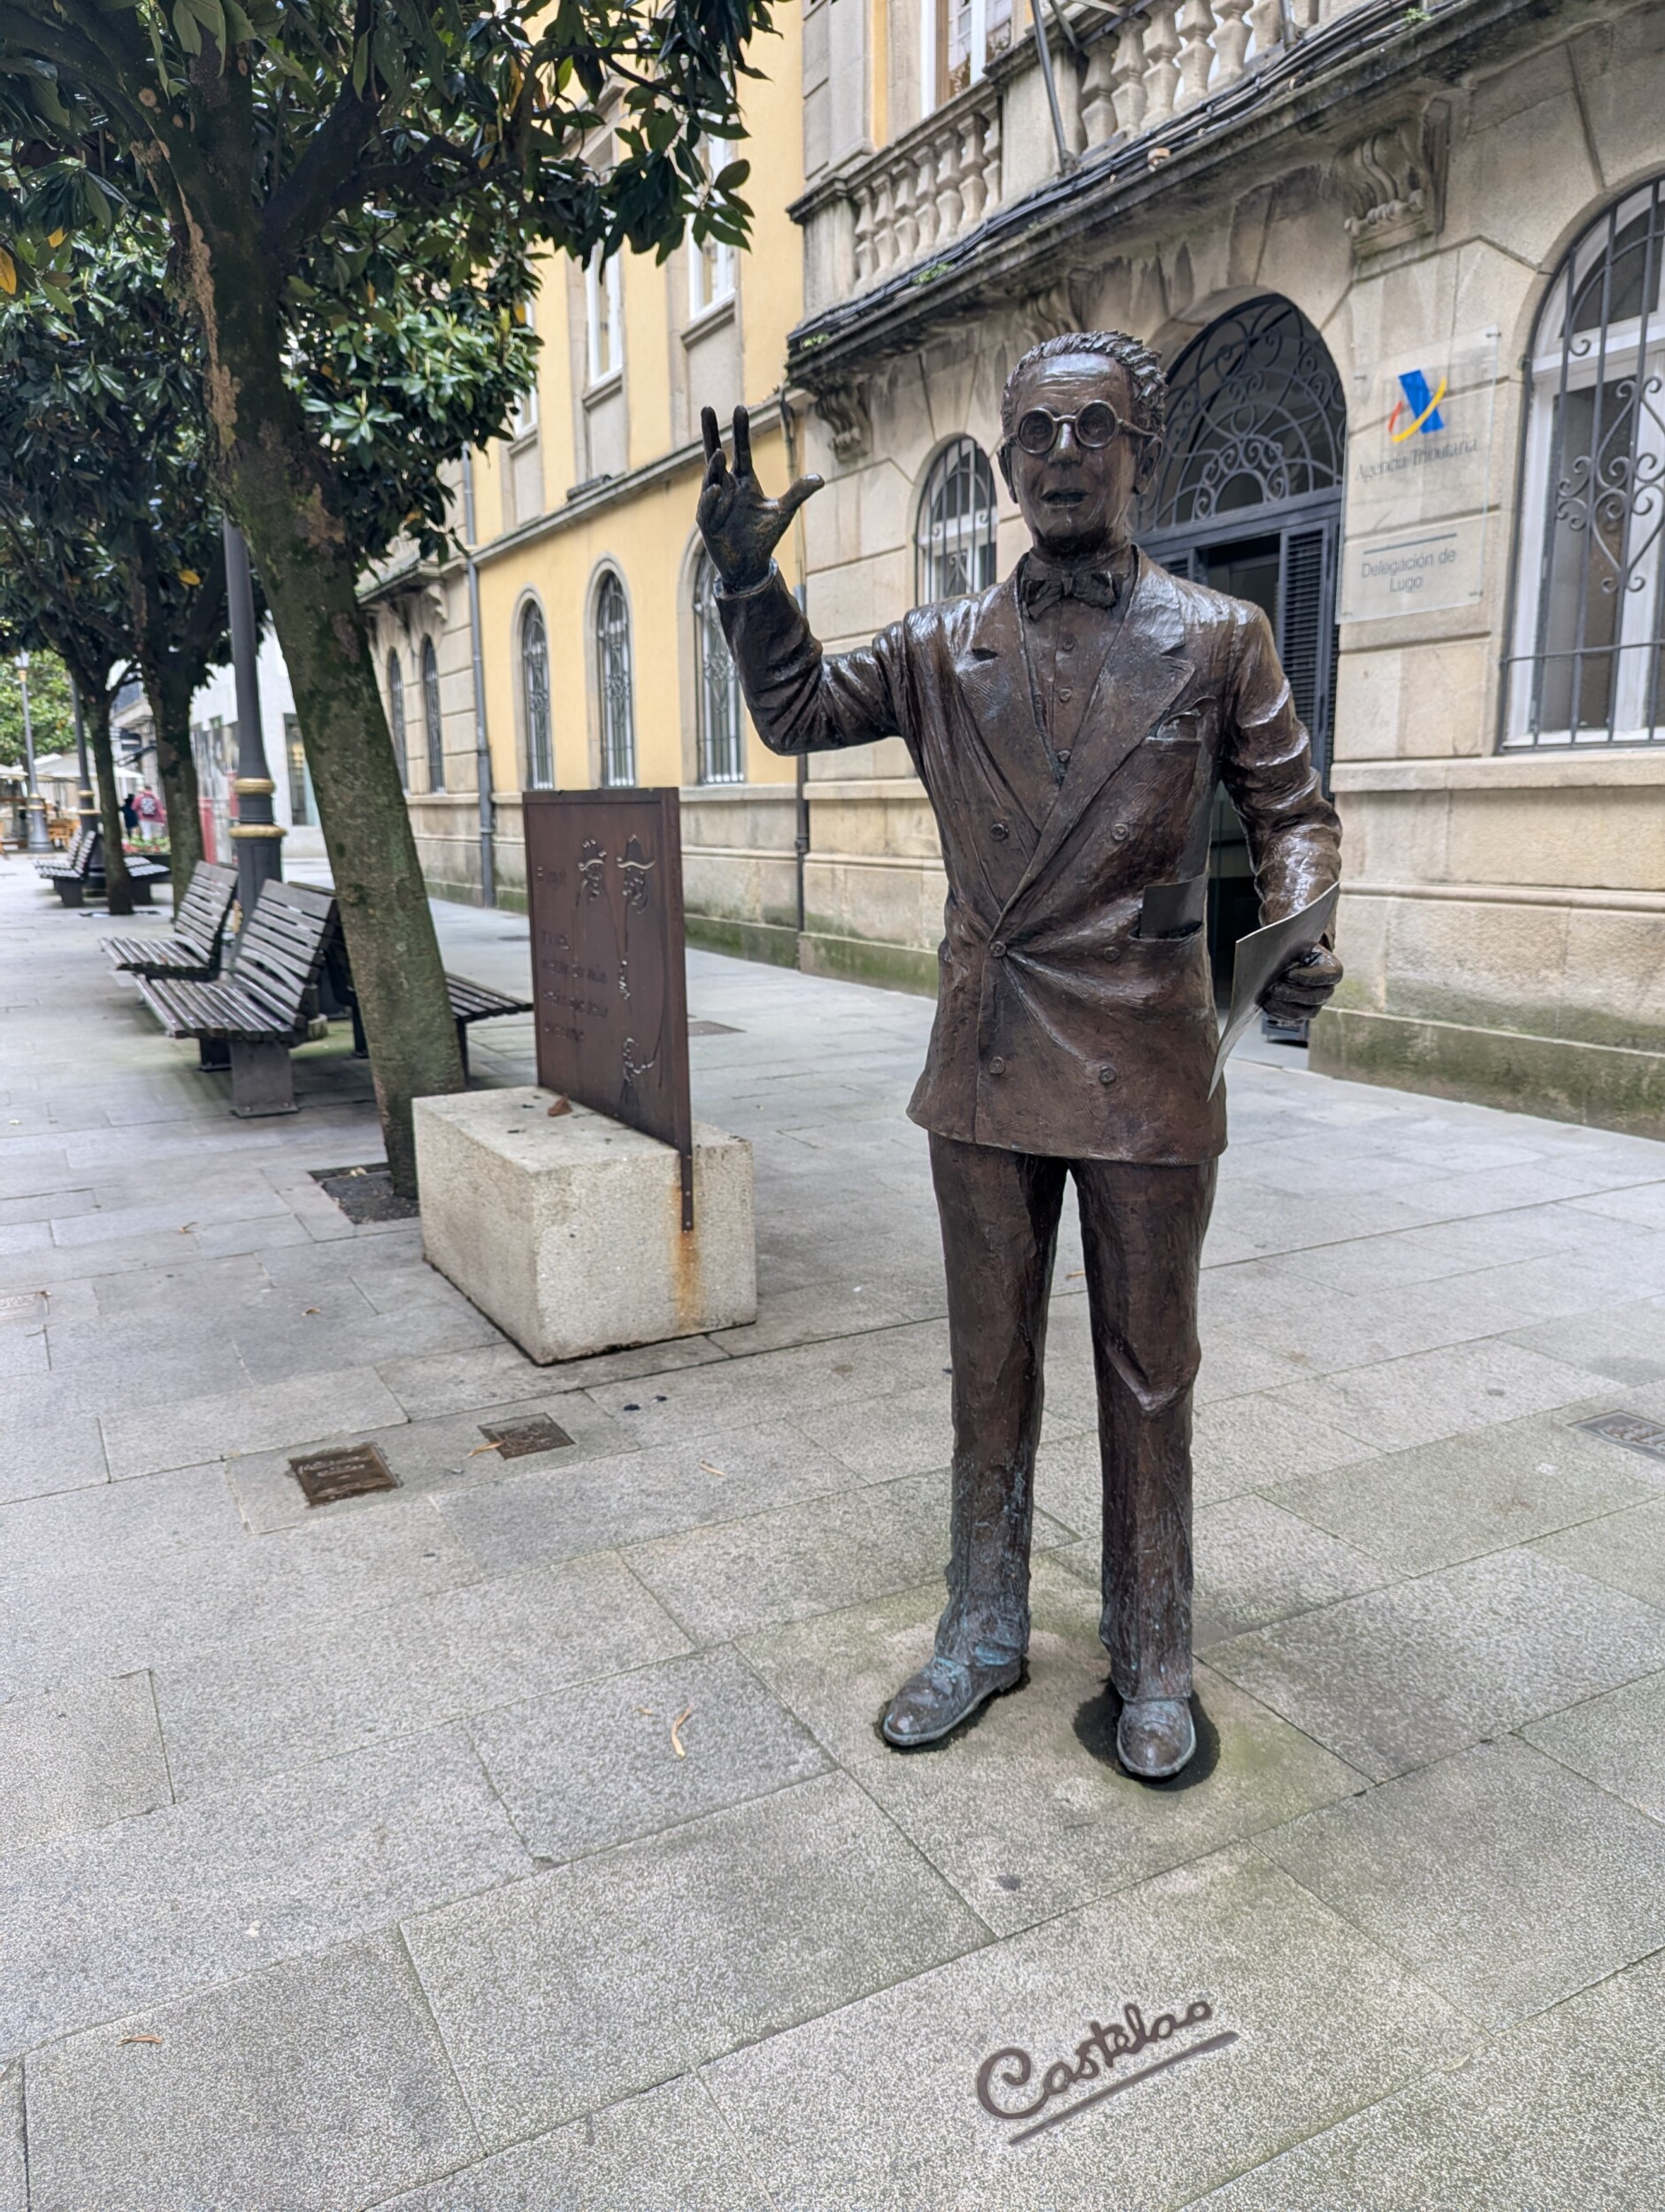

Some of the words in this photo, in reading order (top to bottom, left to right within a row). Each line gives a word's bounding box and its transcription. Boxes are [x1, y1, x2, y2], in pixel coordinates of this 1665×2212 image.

[1356, 456, 1407, 482] Agencia
[1411, 438, 1478, 466] Tributaria
[1362, 551, 1434, 579] Delegación
[1439, 548, 1458, 564] de
[1389, 576, 1423, 594] Lugo
[977, 2001, 1213, 2120] Castelao
